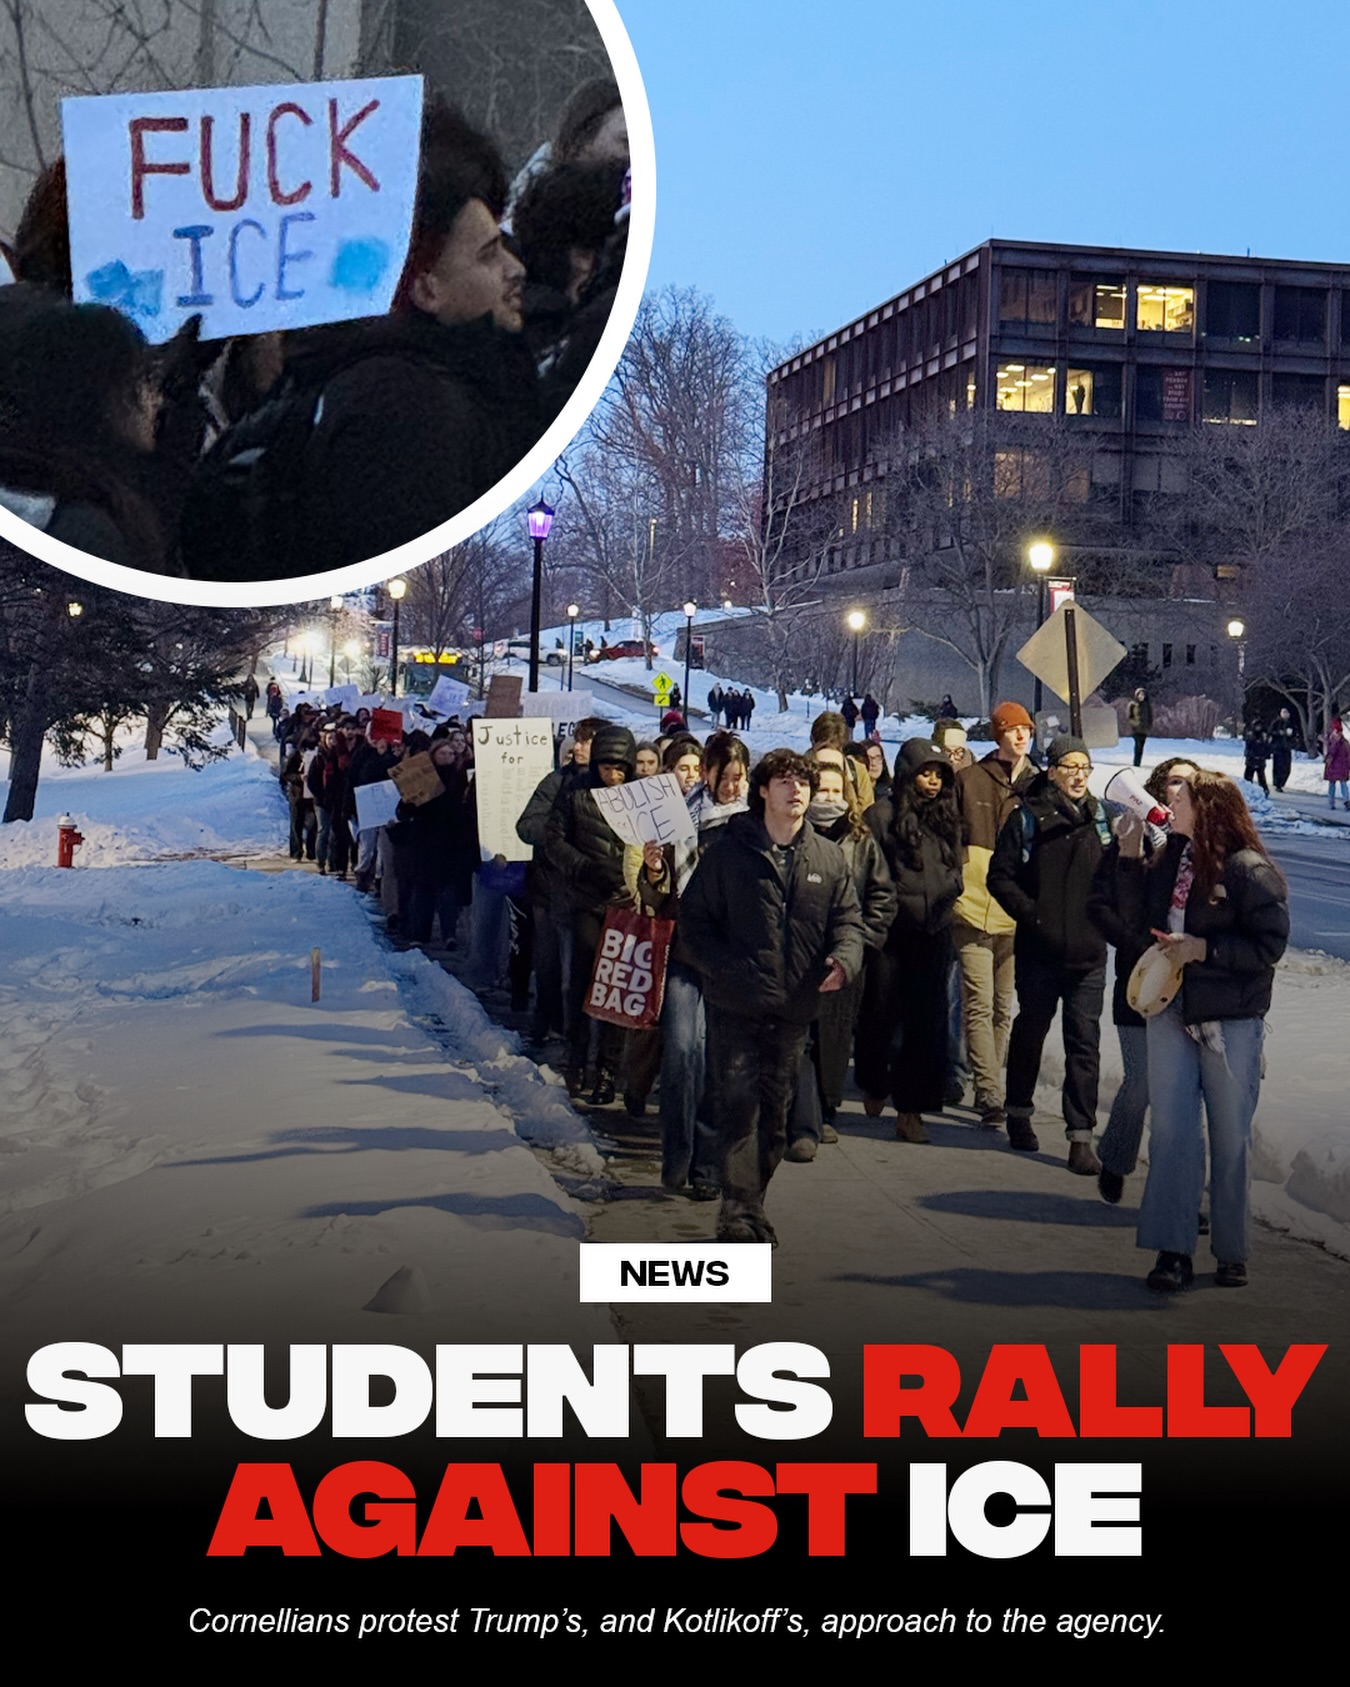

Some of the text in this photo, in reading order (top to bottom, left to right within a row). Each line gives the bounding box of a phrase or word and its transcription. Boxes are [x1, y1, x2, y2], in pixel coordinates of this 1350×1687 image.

[130, 98, 380, 219] FUCK
[172, 212, 317, 309] ICE
[477, 724, 548, 746] Justice
[501, 752, 524, 764] for
[596, 775, 676, 814] ABOLISH
[626, 804, 676, 844] ICE
[600, 928, 653, 970] BIG
[595, 958, 653, 993] RED
[589, 982, 646, 1017] BAG
